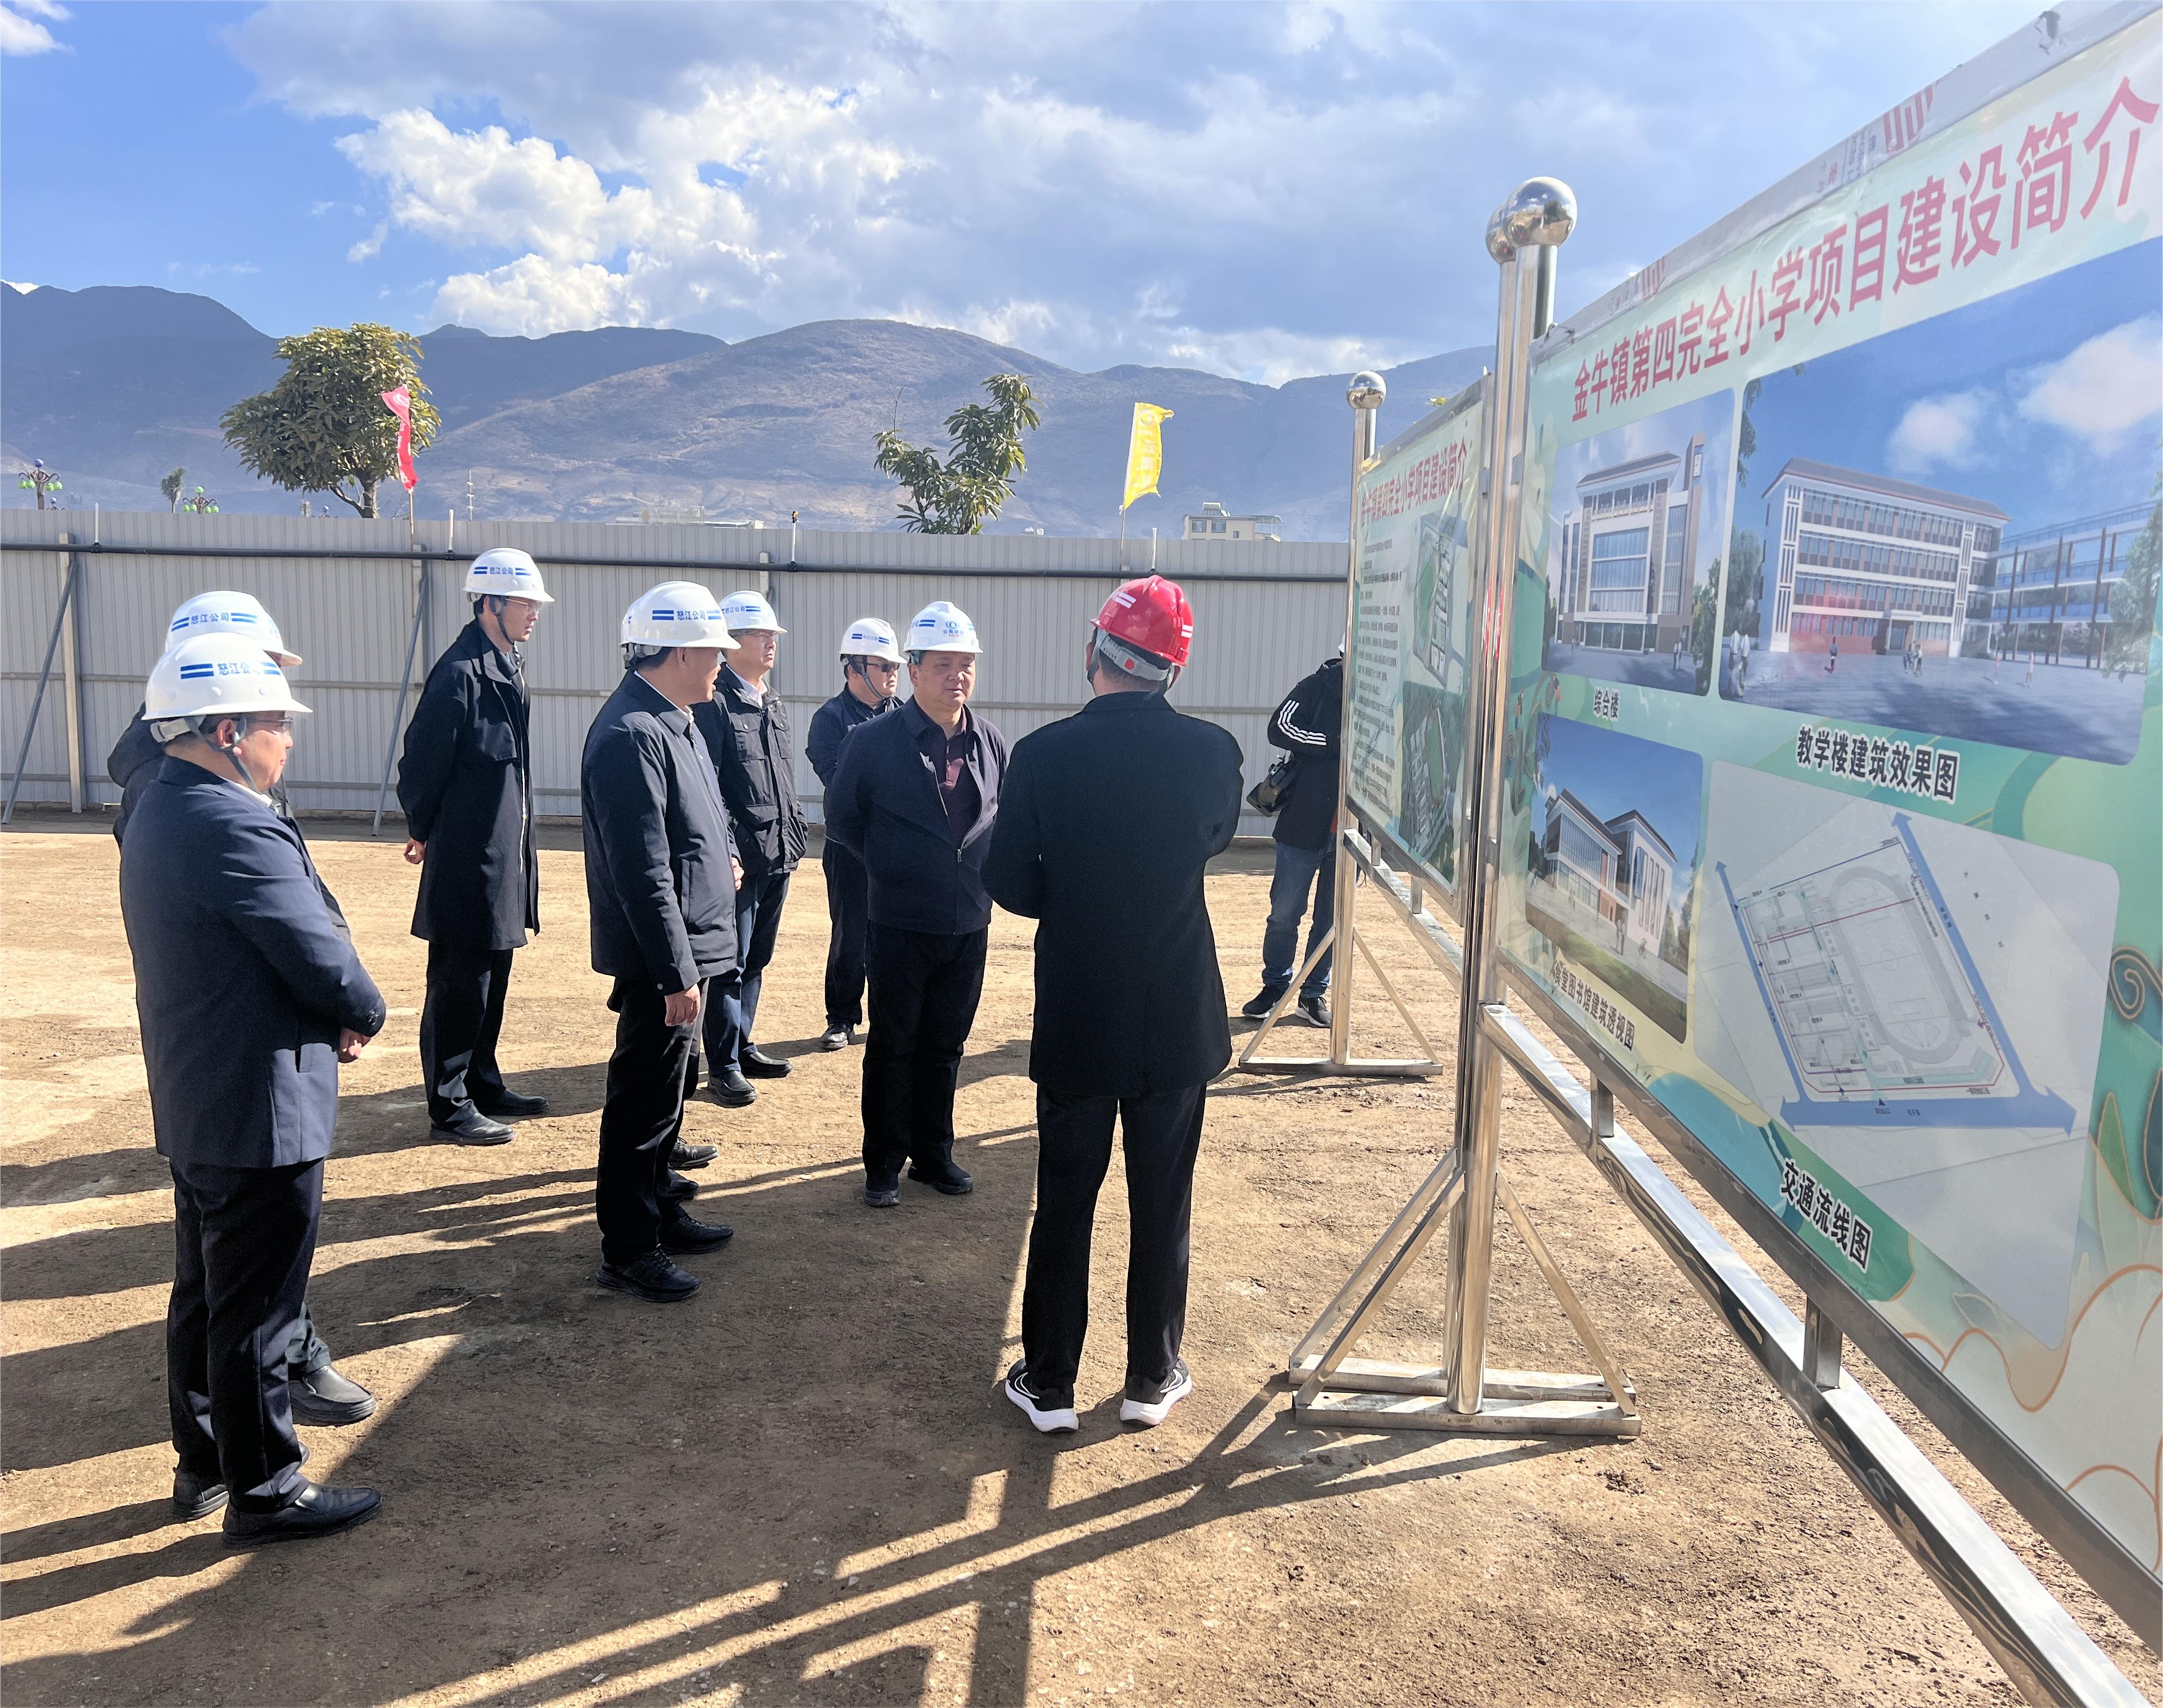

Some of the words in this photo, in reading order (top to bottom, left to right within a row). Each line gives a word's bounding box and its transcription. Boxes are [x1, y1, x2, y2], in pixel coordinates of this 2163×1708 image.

[1572, 76, 2160, 422] 金牛镇第四完全小学项目建设简介
[489, 567, 514, 575] 怒江公司
[190, 612, 229, 625] 怒江公司
[677, 610, 706, 620] 怒江公司
[217, 662, 260, 676] 怒江公
[1593, 688, 1619, 720] 综合楼
[1797, 726, 1959, 800] 教学楼建筑效果图
[1781, 1161, 1871, 1270] 交通流线图
